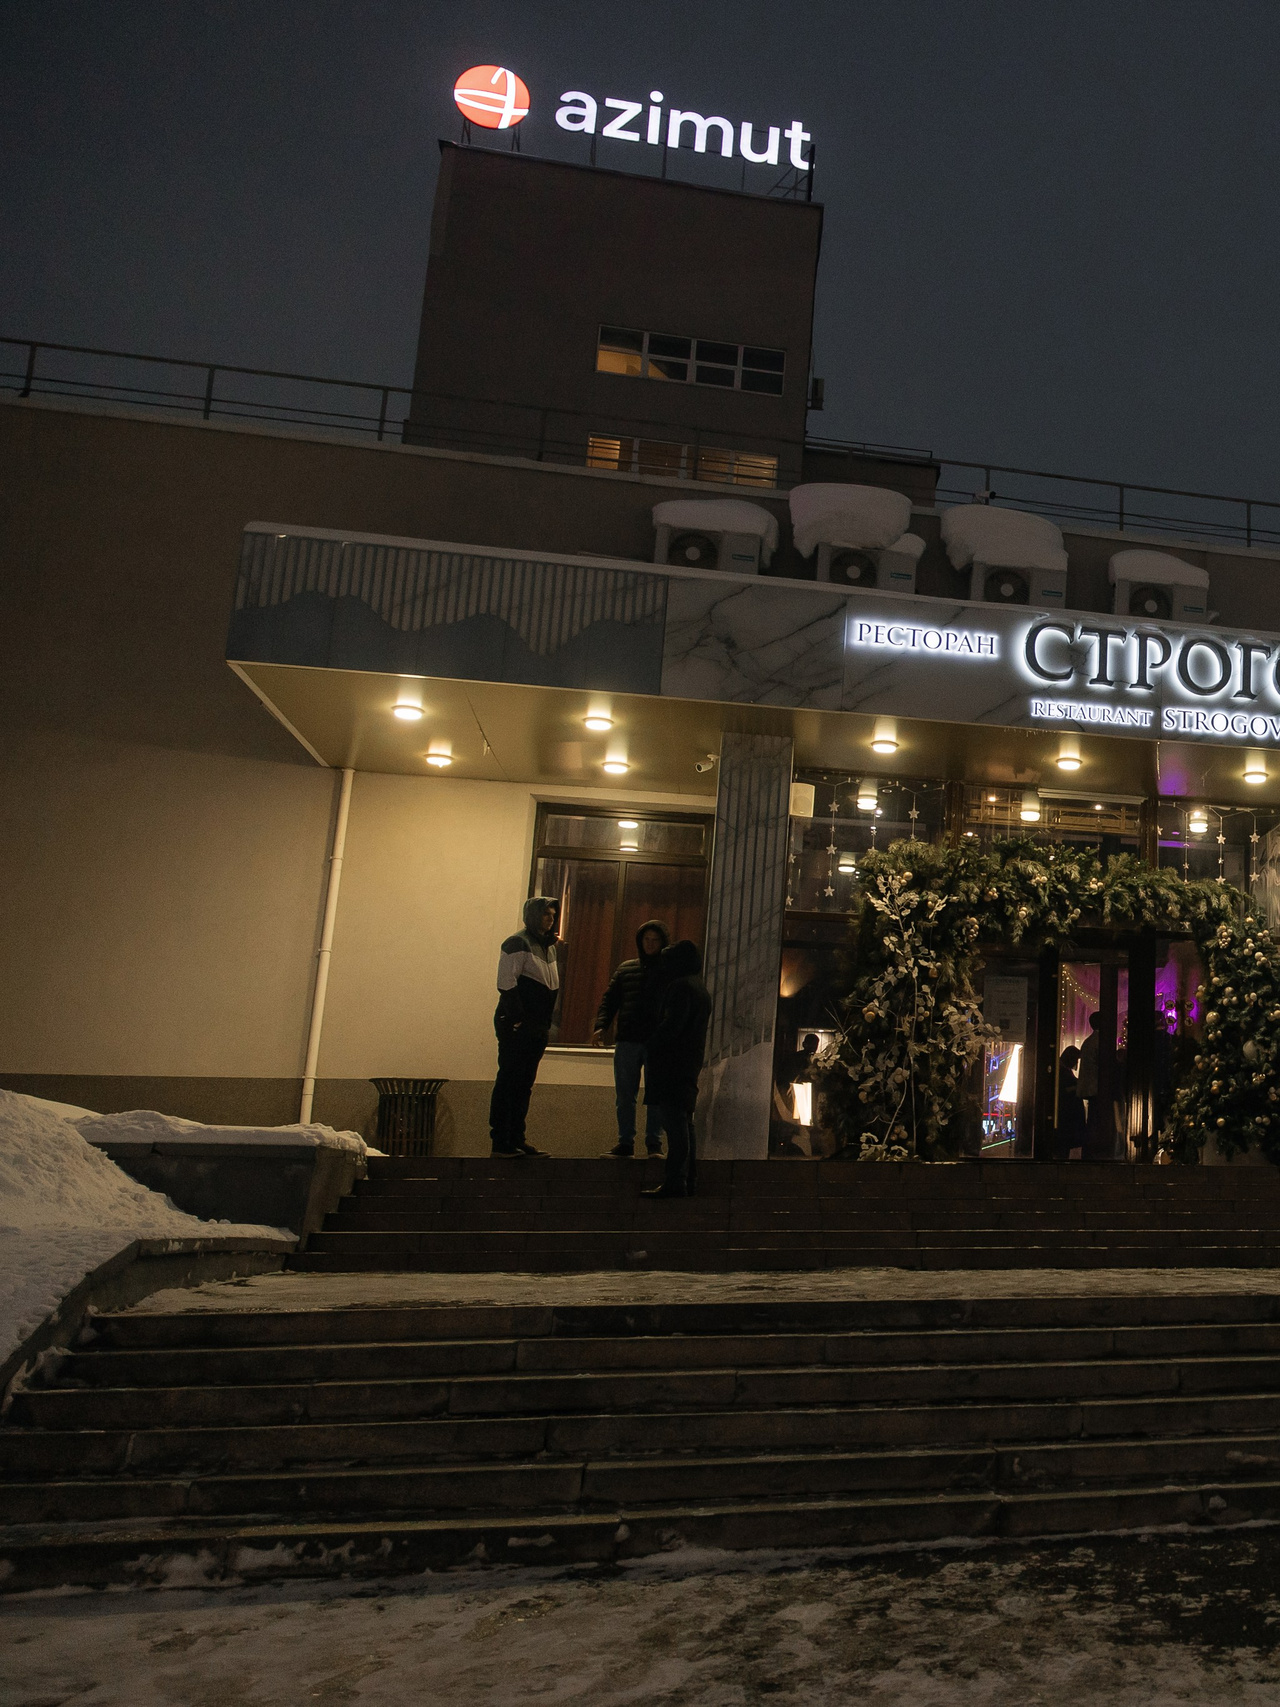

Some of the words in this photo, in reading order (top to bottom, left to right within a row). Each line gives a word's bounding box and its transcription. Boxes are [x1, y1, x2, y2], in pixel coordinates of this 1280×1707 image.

[555, 90, 815, 171] azimut
[856, 622, 996, 656] РЕСТОРАН
[1033, 701, 1154, 727] RESTAURANT
